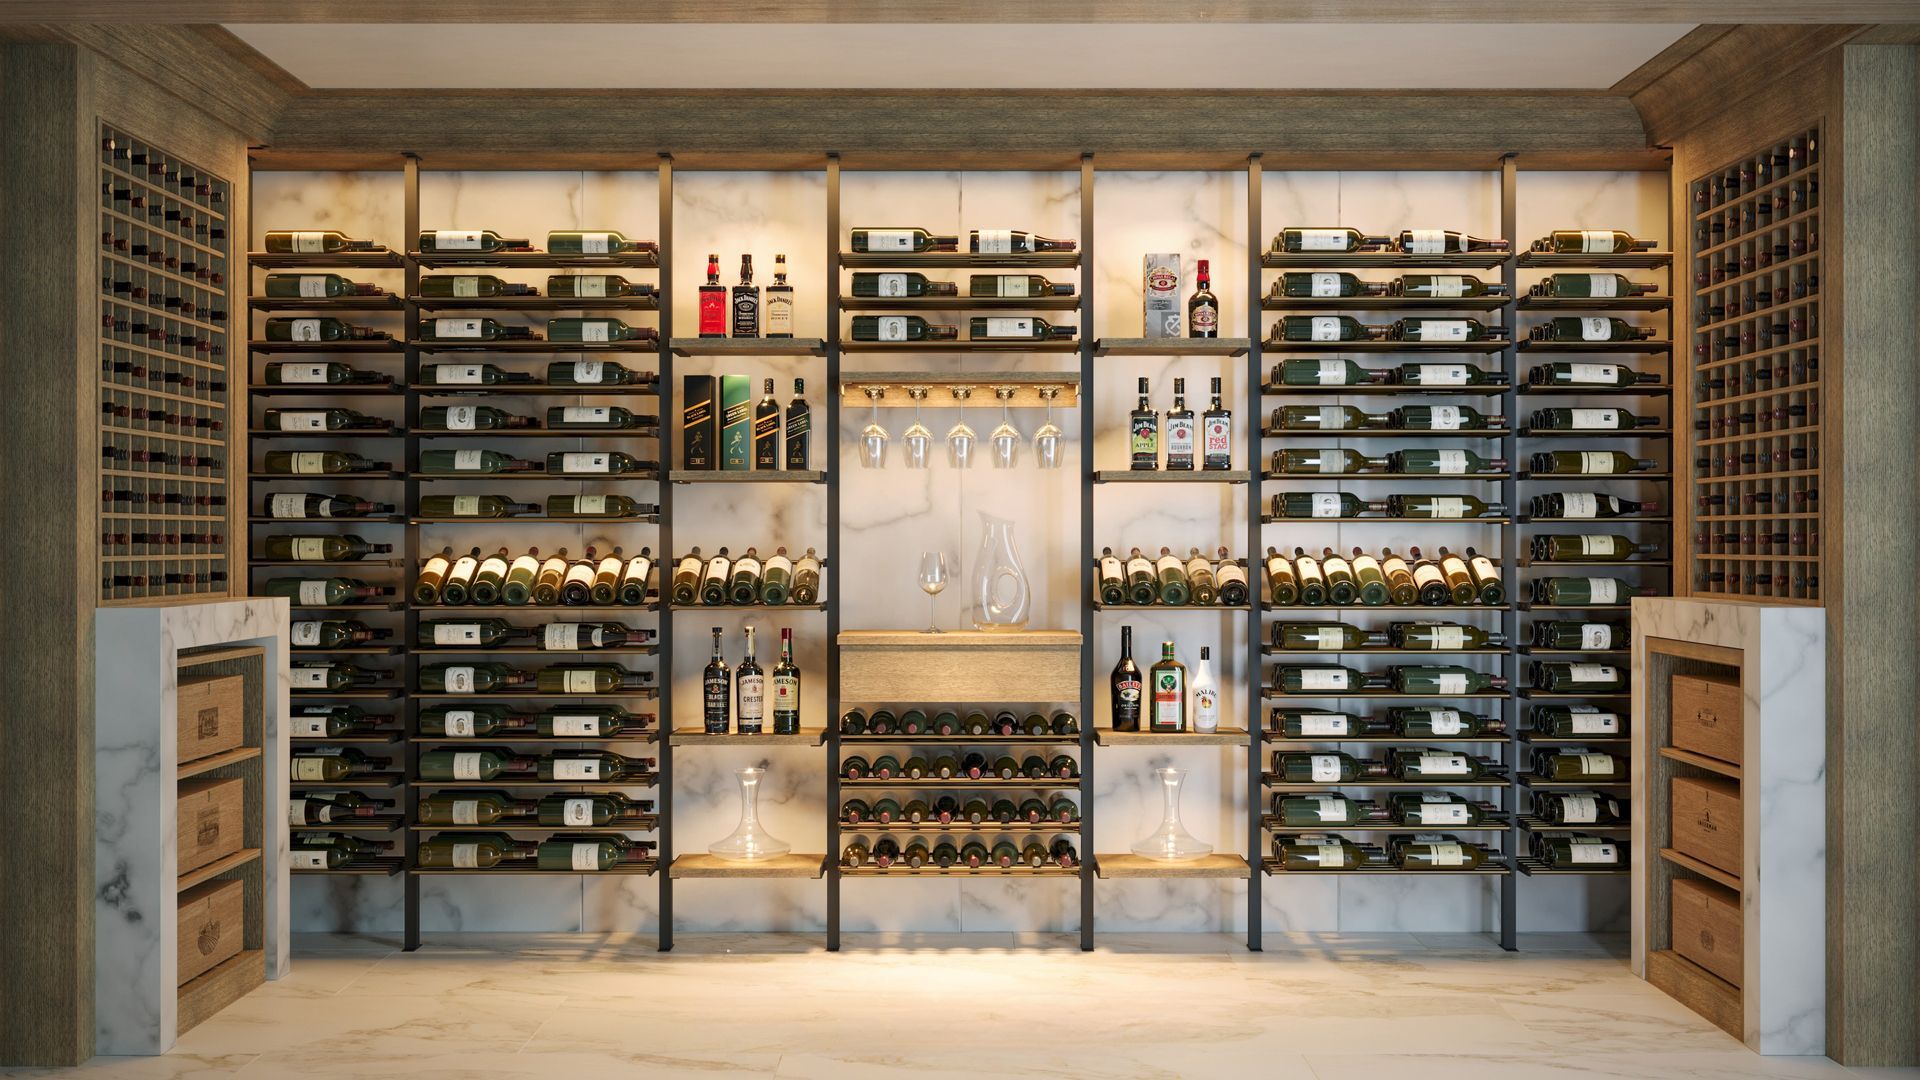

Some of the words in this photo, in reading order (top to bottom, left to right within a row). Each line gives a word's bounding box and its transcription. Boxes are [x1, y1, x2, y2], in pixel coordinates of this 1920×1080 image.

[1134, 423, 1142, 431] JIM
[1143, 421, 1156, 430] BEAM
[1209, 435, 1227, 443] red
[1196, 689, 1216, 697] MALIBU
